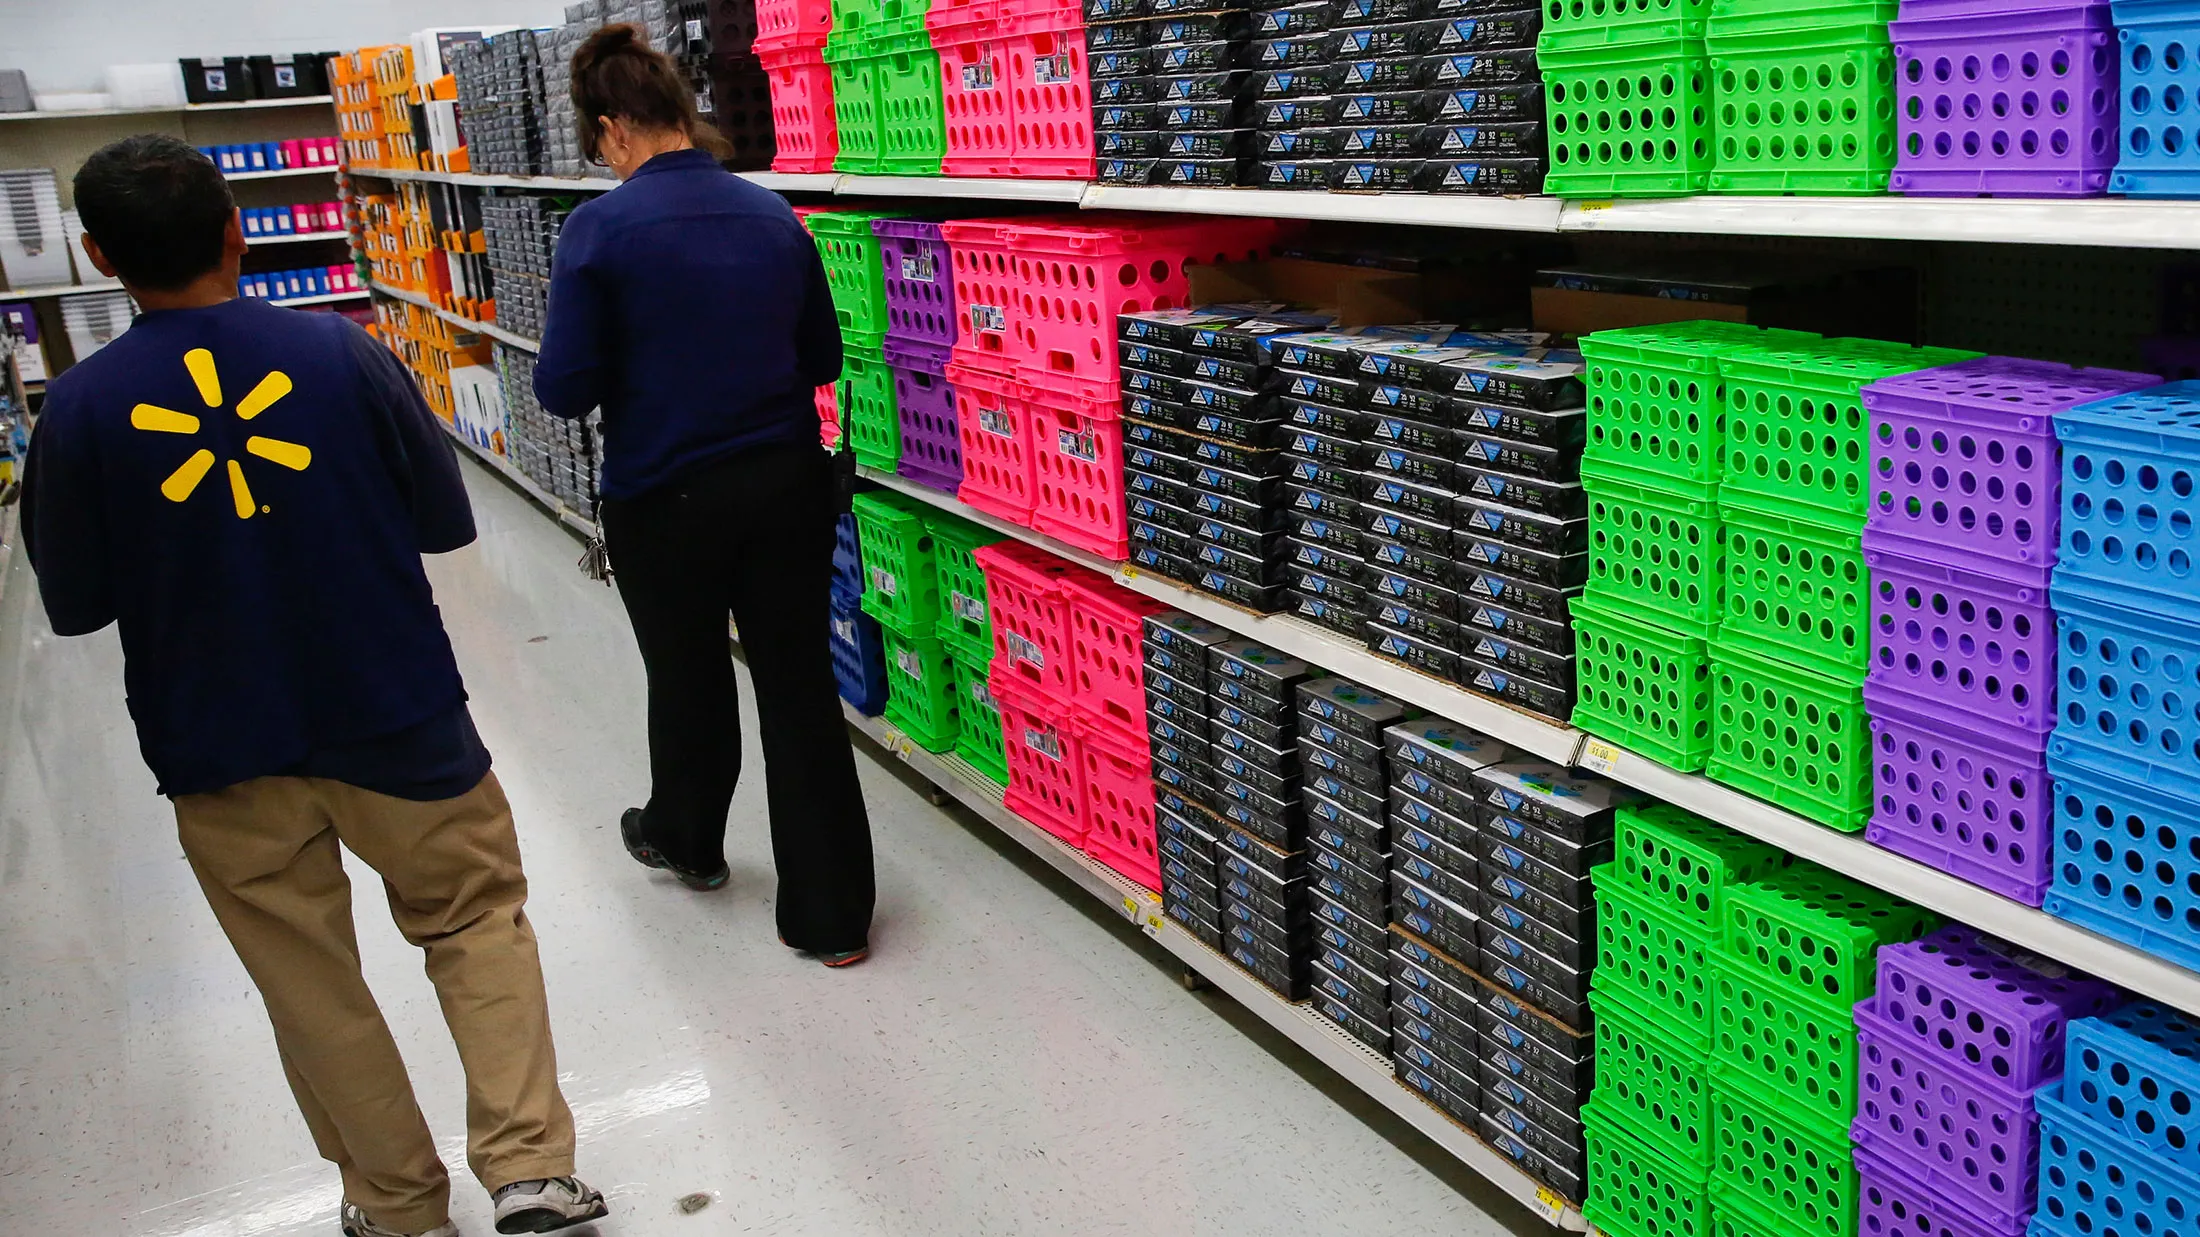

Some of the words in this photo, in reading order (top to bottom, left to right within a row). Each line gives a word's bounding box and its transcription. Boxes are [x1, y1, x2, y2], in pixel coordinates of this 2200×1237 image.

[1489, 379, 1496, 387] 20
[1498, 380, 1506, 388] 92
[1503, 415, 1510, 423] 20
[1512, 417, 1519, 425] 92
[1502, 449, 1508, 457] 20
[1511, 451, 1518, 459] 92
[1506, 484, 1513, 492] 20
[1516, 486, 1523, 494] 92
[1504, 519, 1511, 527] 20
[1514, 522, 1521, 530] 92
[1502, 551, 1509, 559] 20
[1512, 554, 1519, 562] 92
[1505, 585, 1512, 593] 20
[1515, 588, 1522, 596] 92
[1507, 618, 1514, 626] 20
[1516, 621, 1524, 629] 92
[1509, 649, 1516, 657] 20
[1519, 652, 1526, 660] 92
[1509, 681, 1516, 689] 20
[1518, 685, 1525, 693] 92
[1522, 802, 1529, 810] 20
[1533, 805, 1540, 814] 92
[1524, 831, 1531, 840] 20
[1533, 835, 1540, 844] 92
[1524, 861, 1531, 870] 20
[1533, 867, 1540, 876] 92
[1524, 892, 1532, 901] 20
[1534, 897, 1541, 906] 92
[1524, 922, 1531, 931] 20
[1533, 927, 1540, 936] 92
